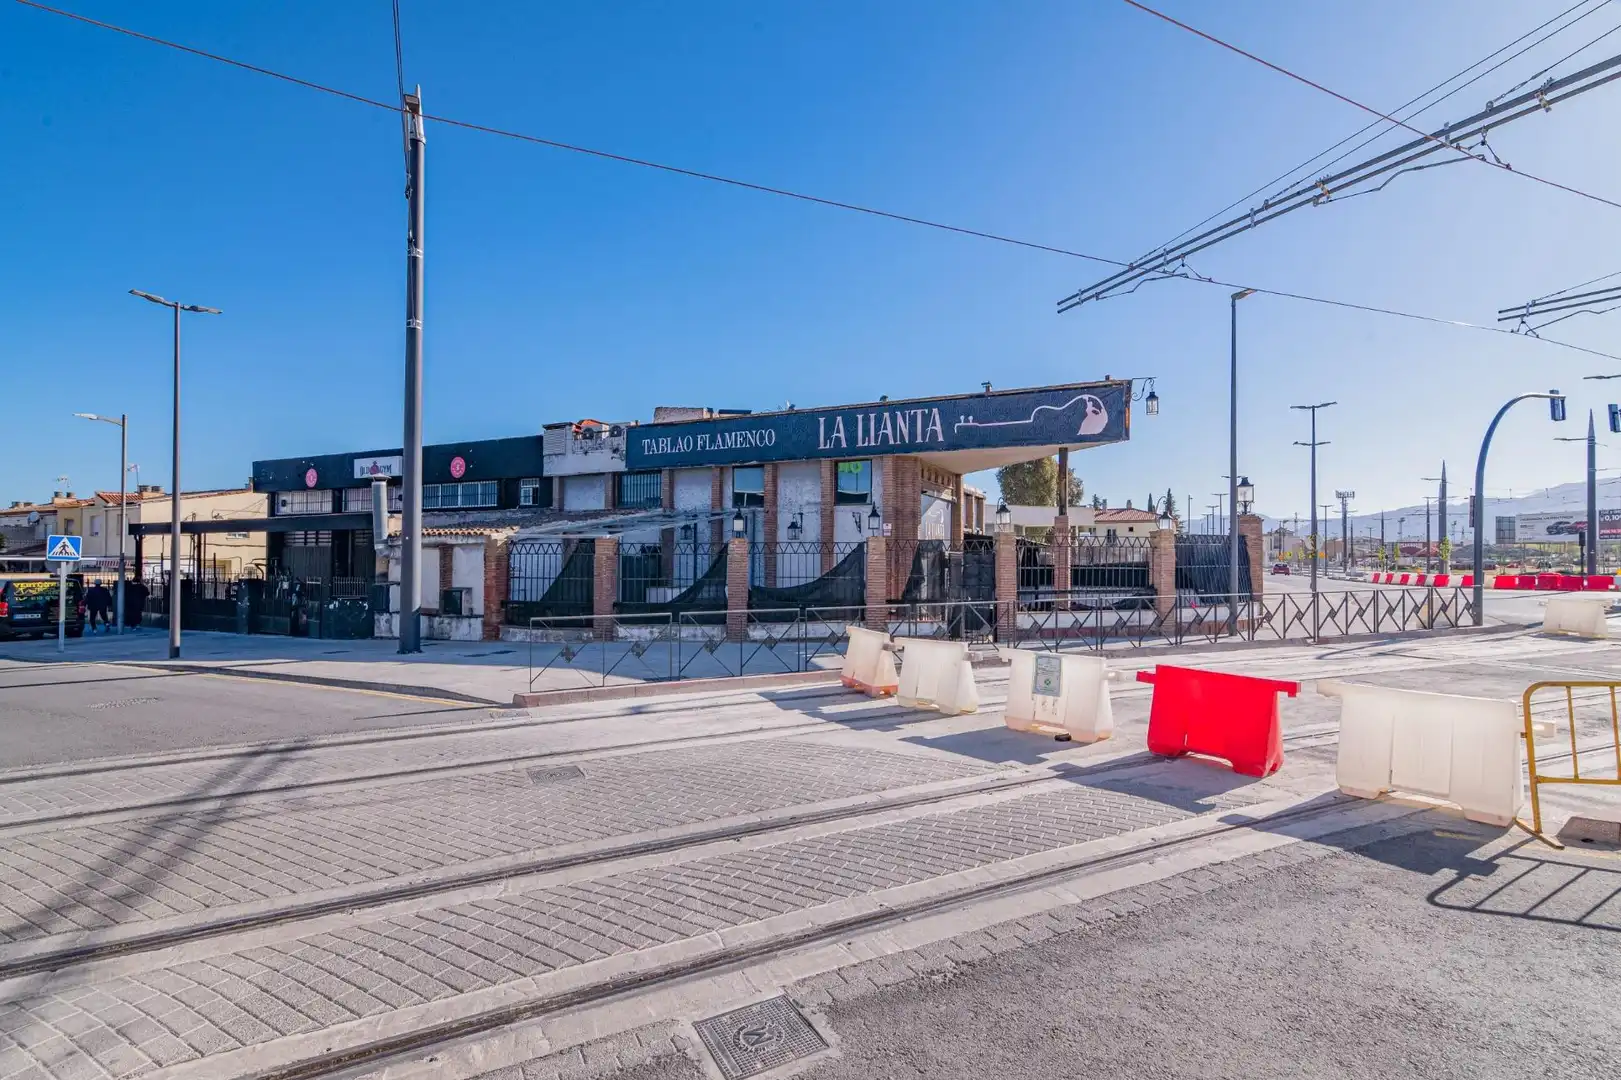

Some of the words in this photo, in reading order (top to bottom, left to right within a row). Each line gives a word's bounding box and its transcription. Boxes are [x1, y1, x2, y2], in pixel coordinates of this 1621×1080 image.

[642, 435, 693, 455] TABLAO
[696, 428, 776, 451] FLAMENCO
[818, 416, 848, 450] LA
[855, 408, 944, 447] LIANTA
